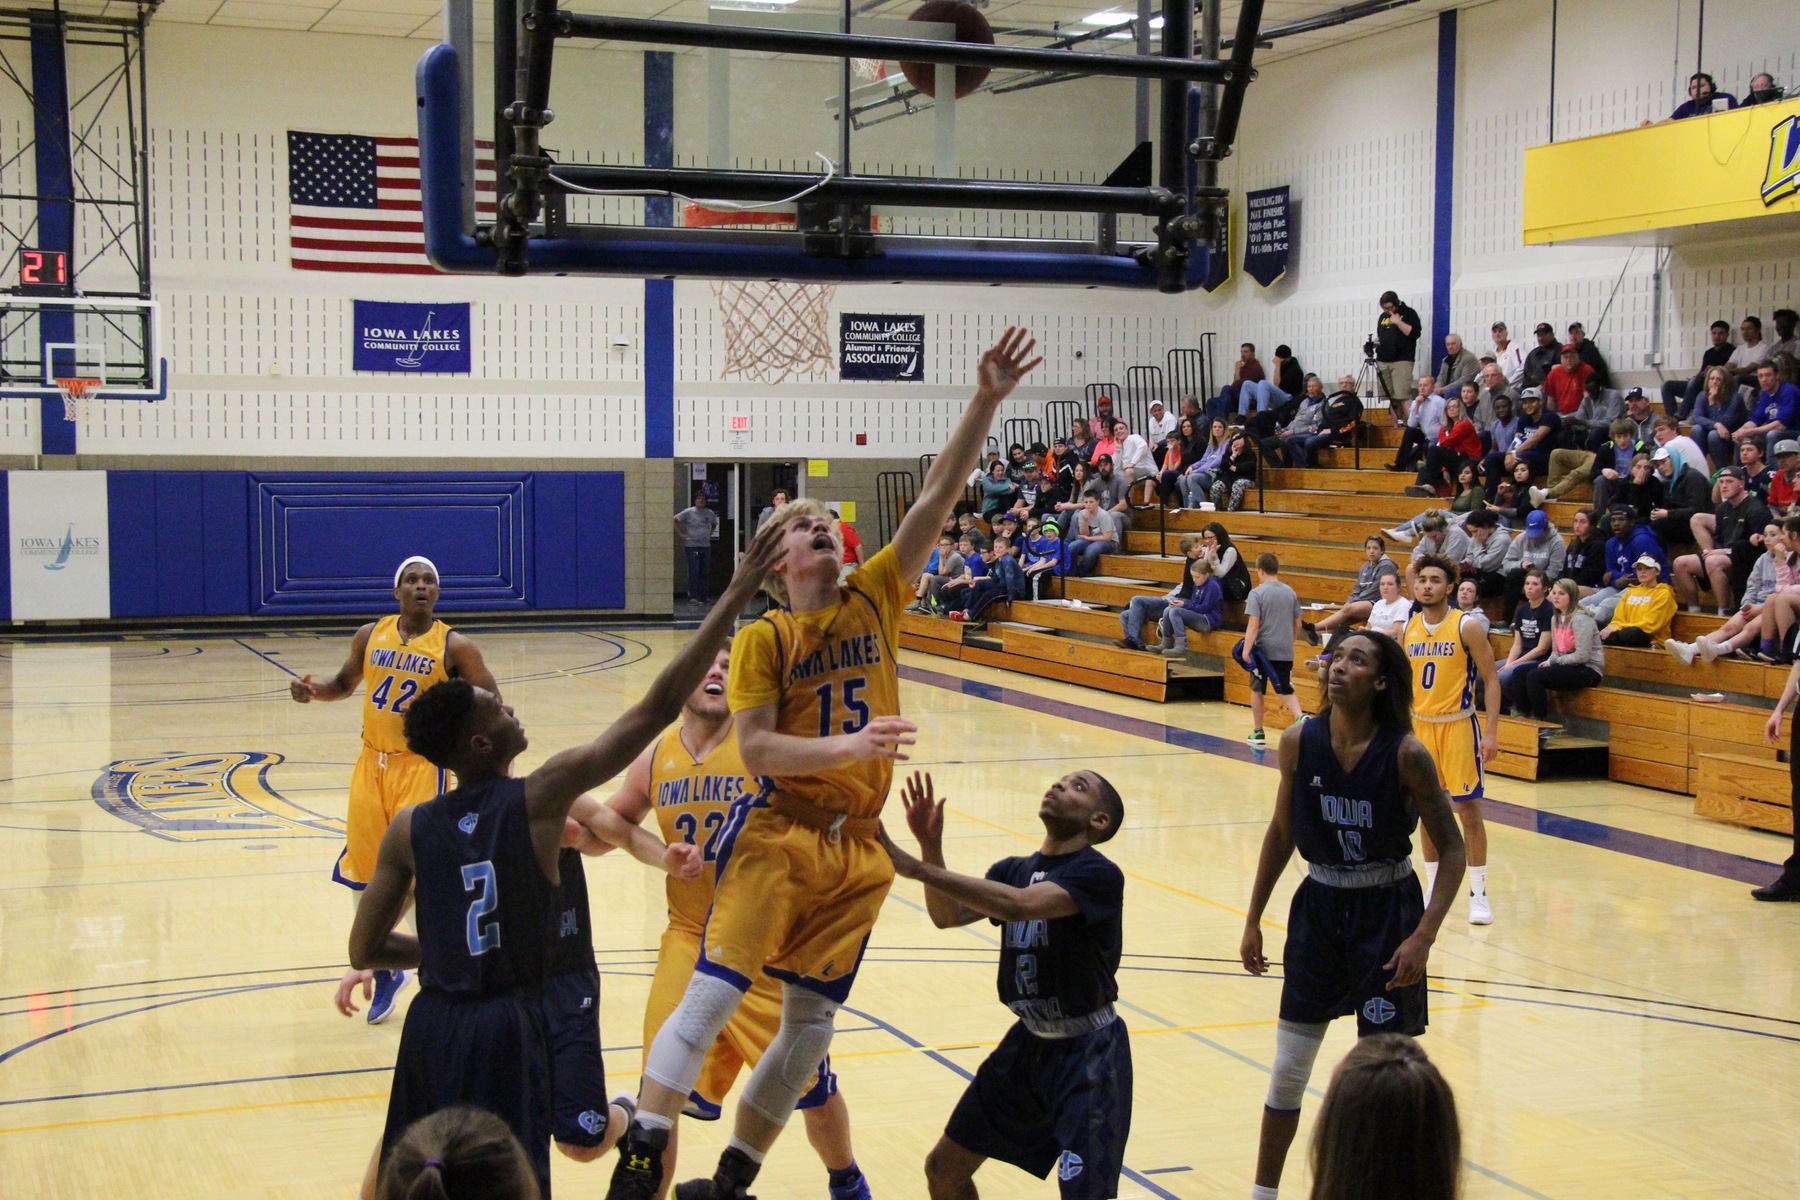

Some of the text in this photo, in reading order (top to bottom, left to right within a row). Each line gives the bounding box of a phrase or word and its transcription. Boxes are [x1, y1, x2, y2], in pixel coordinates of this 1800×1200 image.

[1263, 206, 1285, 219] FINISHE
[23, 252, 65, 284] 21
[364, 327, 460, 340] IOWA LAKES
[845, 332, 921, 342] COMMUNITY COLLEGE
[851, 321, 916, 333] IOWA LAKES
[364, 342, 460, 351] COMMUNITY COLLEGE
[845, 344, 876, 352] Alumni
[885, 344, 916, 353] Friends
[845, 353, 908, 364] ASSOCIATION
[732, 416, 748, 429] EXIT
[20, 537, 100, 548] IOWA LAKES
[828, 634, 881, 670] LAKES
[1408, 642, 1456, 657] IOWA LAKES
[371, 648, 436, 676] IOWA LAKES
[1421, 661, 1436, 690] 0
[371, 675, 418, 714] 42
[816, 677, 870, 738] 15
[657, 774, 746, 808] IOWA LAKES
[1320, 793, 1373, 829] IOWA
[675, 811, 726, 862] 32
[461, 860, 500, 957] 2
